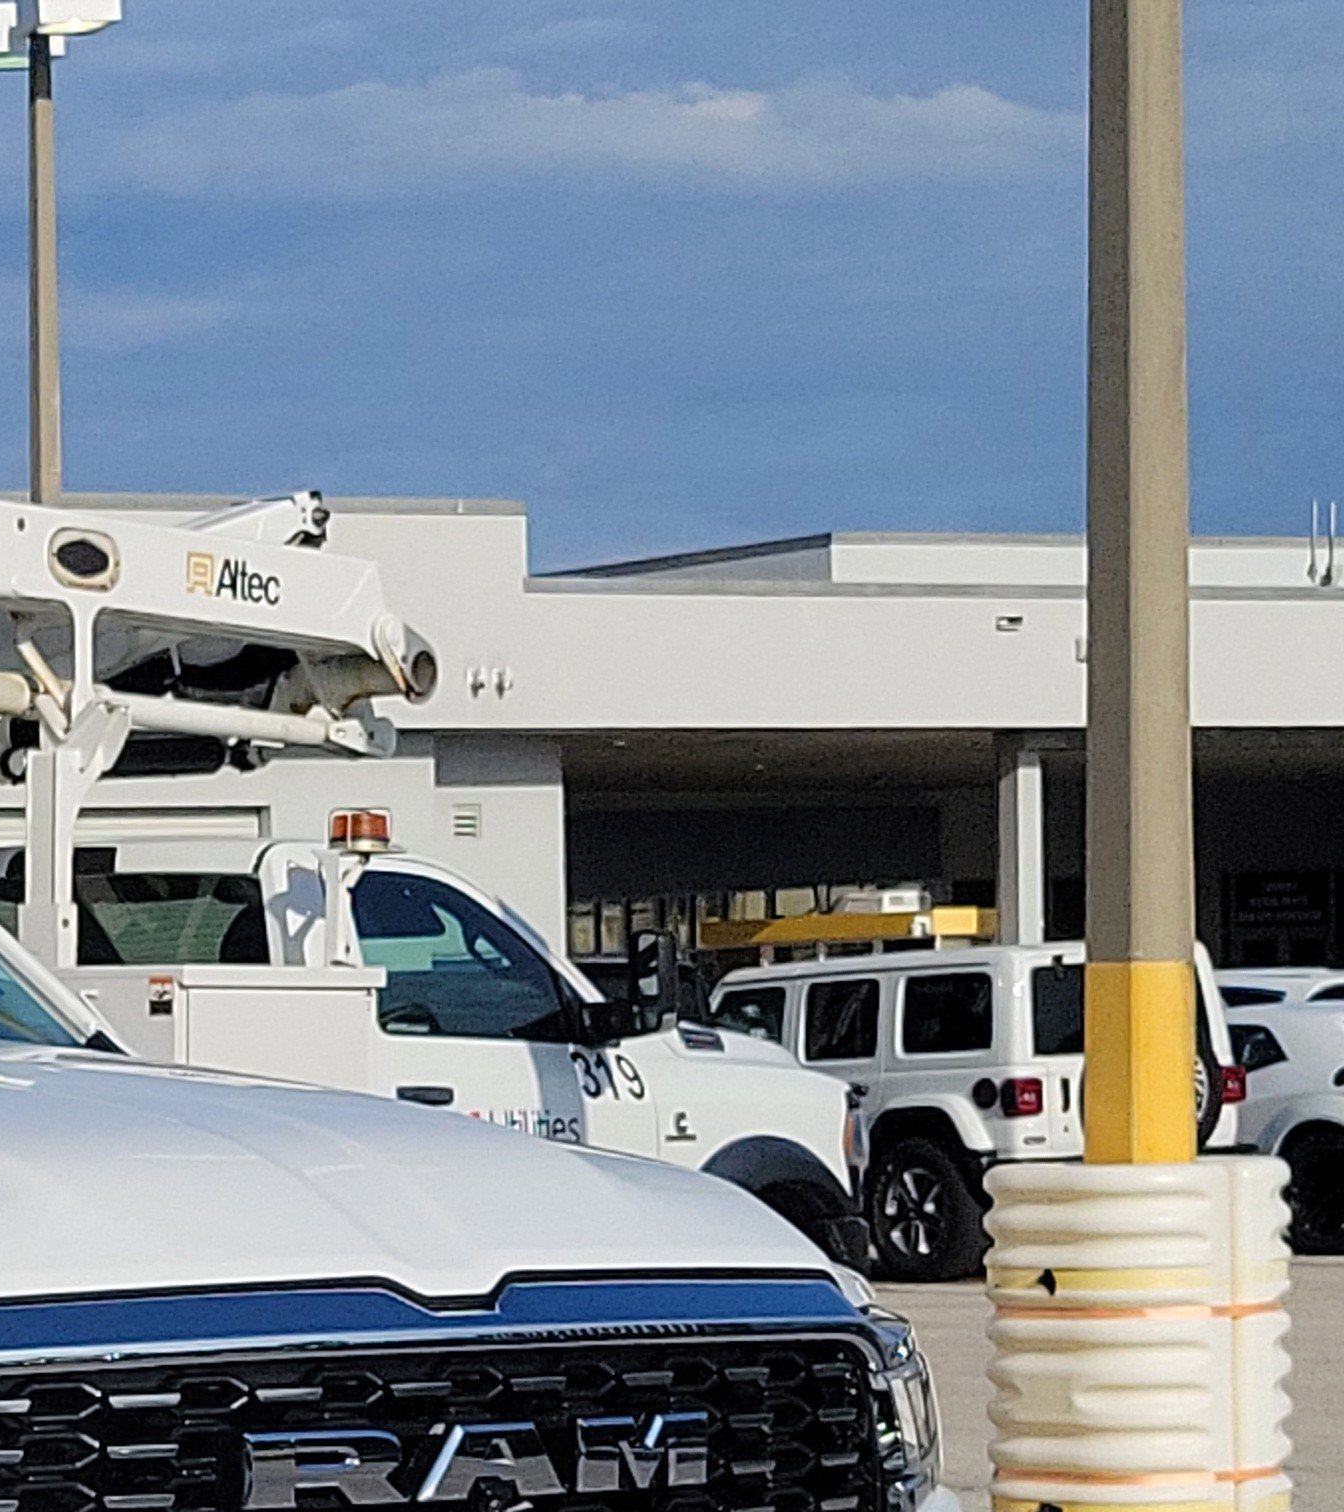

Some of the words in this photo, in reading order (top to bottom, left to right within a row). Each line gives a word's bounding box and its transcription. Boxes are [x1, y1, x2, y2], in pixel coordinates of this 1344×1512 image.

[215, 558, 281, 606] Altec
[570, 1051, 645, 1101] 319
[243, 1411, 708, 1510] RAM
